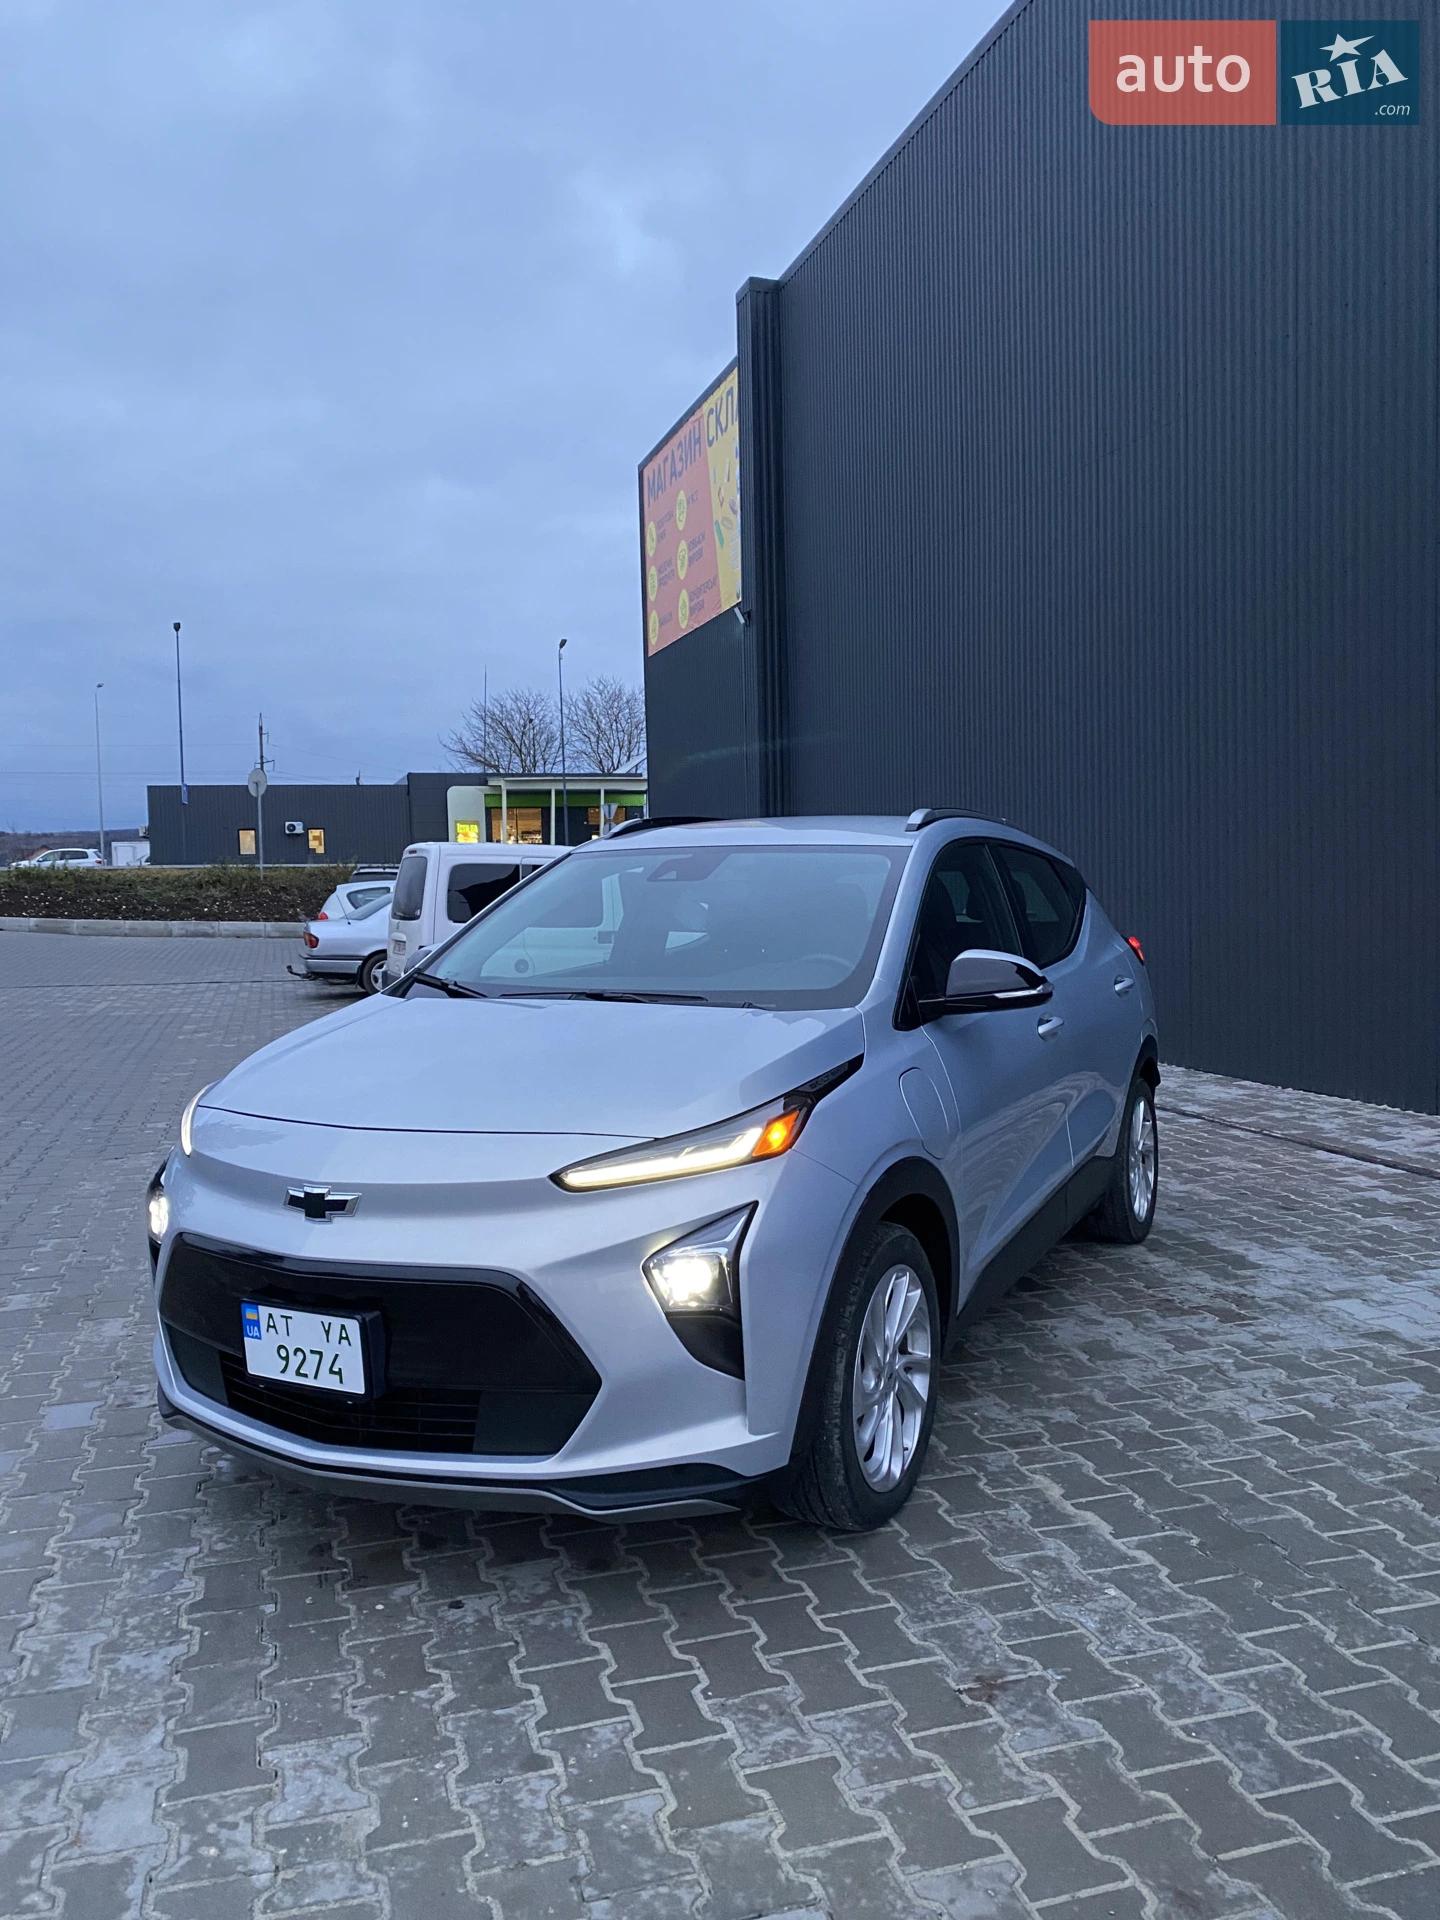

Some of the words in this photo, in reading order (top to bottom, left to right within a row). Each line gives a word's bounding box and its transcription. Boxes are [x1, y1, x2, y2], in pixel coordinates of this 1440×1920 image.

[647, 420, 702, 508] МАГАЗИН
[706, 385, 739, 448] СКЛ
[246, 1325, 260, 1338] UA
[266, 1312, 293, 1337] AT
[320, 1320, 352, 1347] YA
[276, 1344, 344, 1385] 9274
